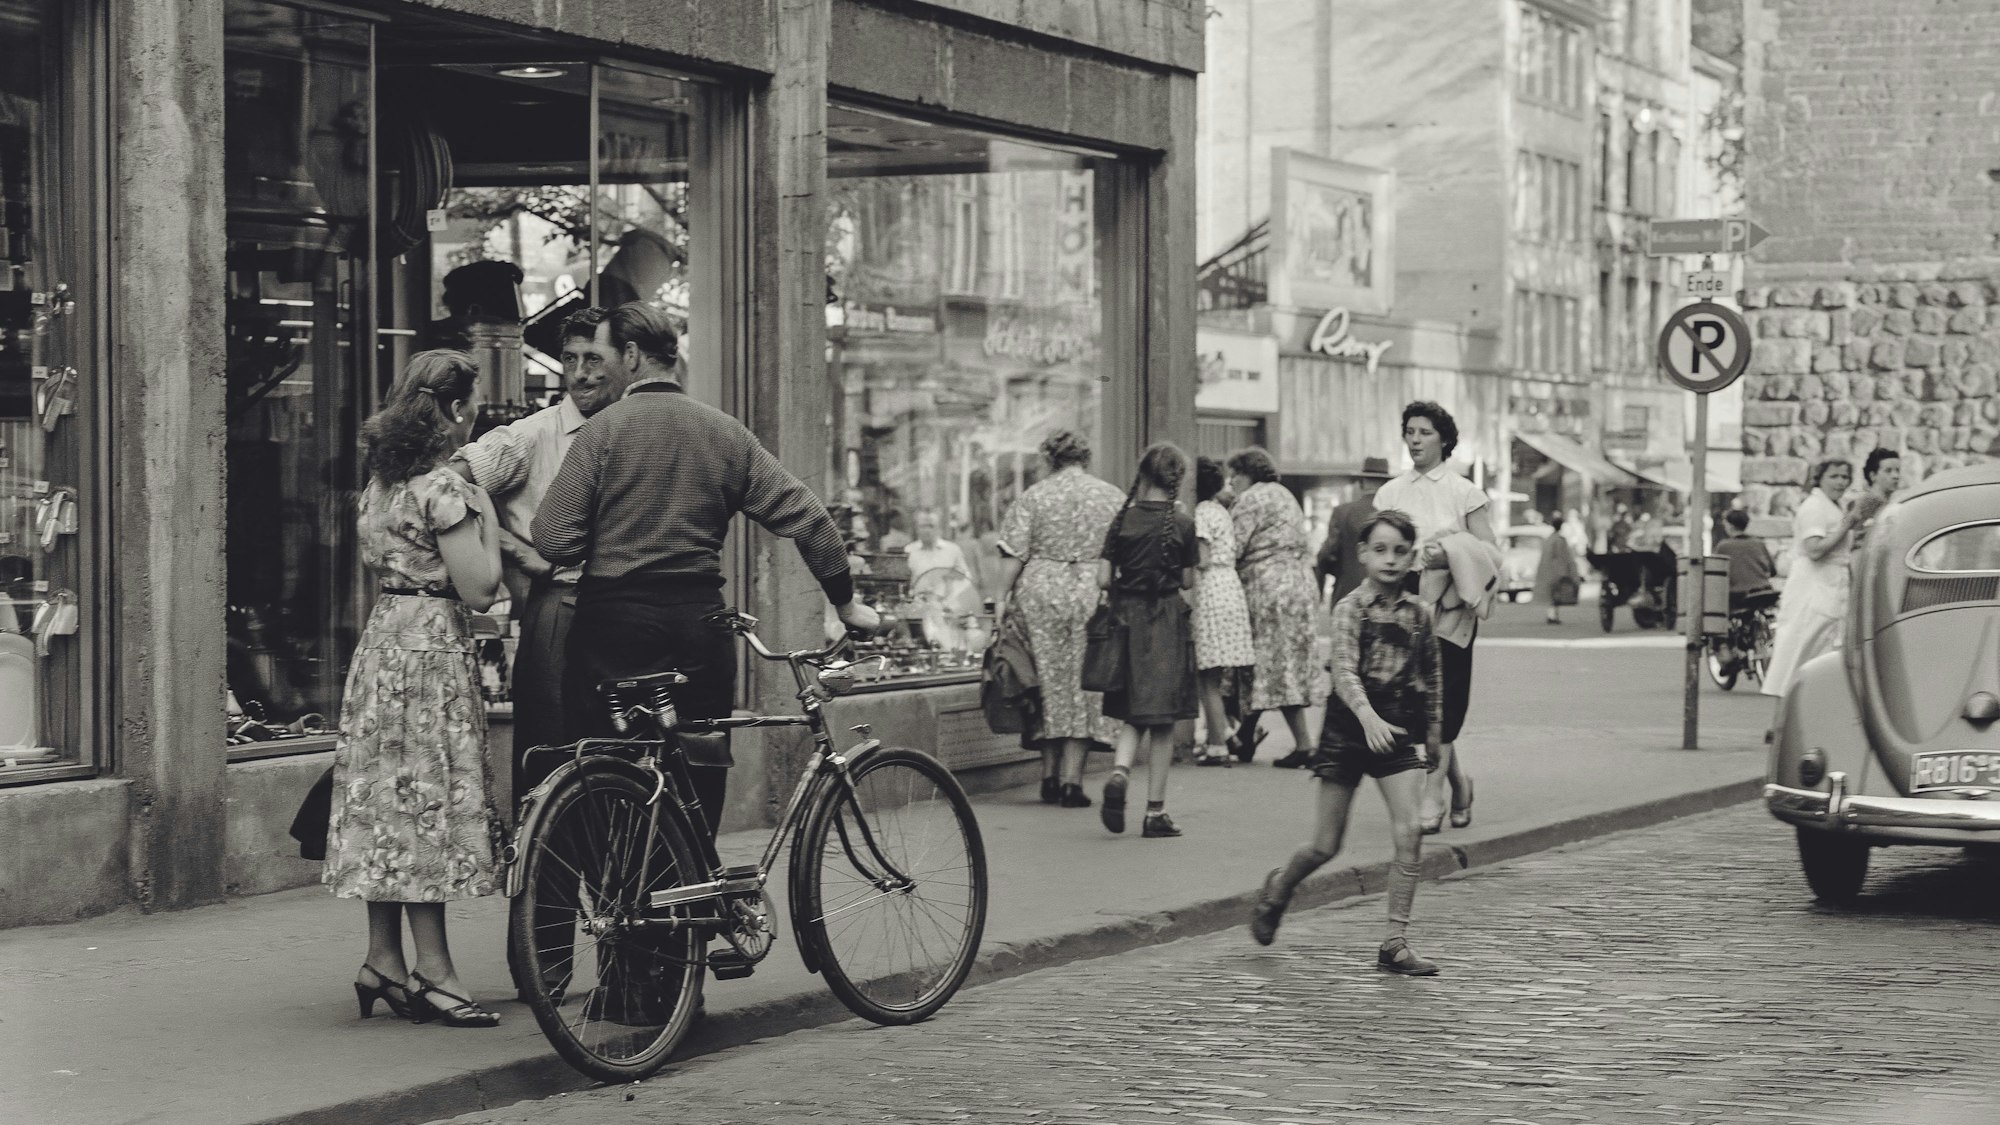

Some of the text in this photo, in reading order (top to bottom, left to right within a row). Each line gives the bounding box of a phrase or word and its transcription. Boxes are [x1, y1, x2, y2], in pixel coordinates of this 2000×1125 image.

[1727, 221, 1745, 251] P
[1687, 275, 1724, 292] Ende
[1691, 320, 1725, 374] P
